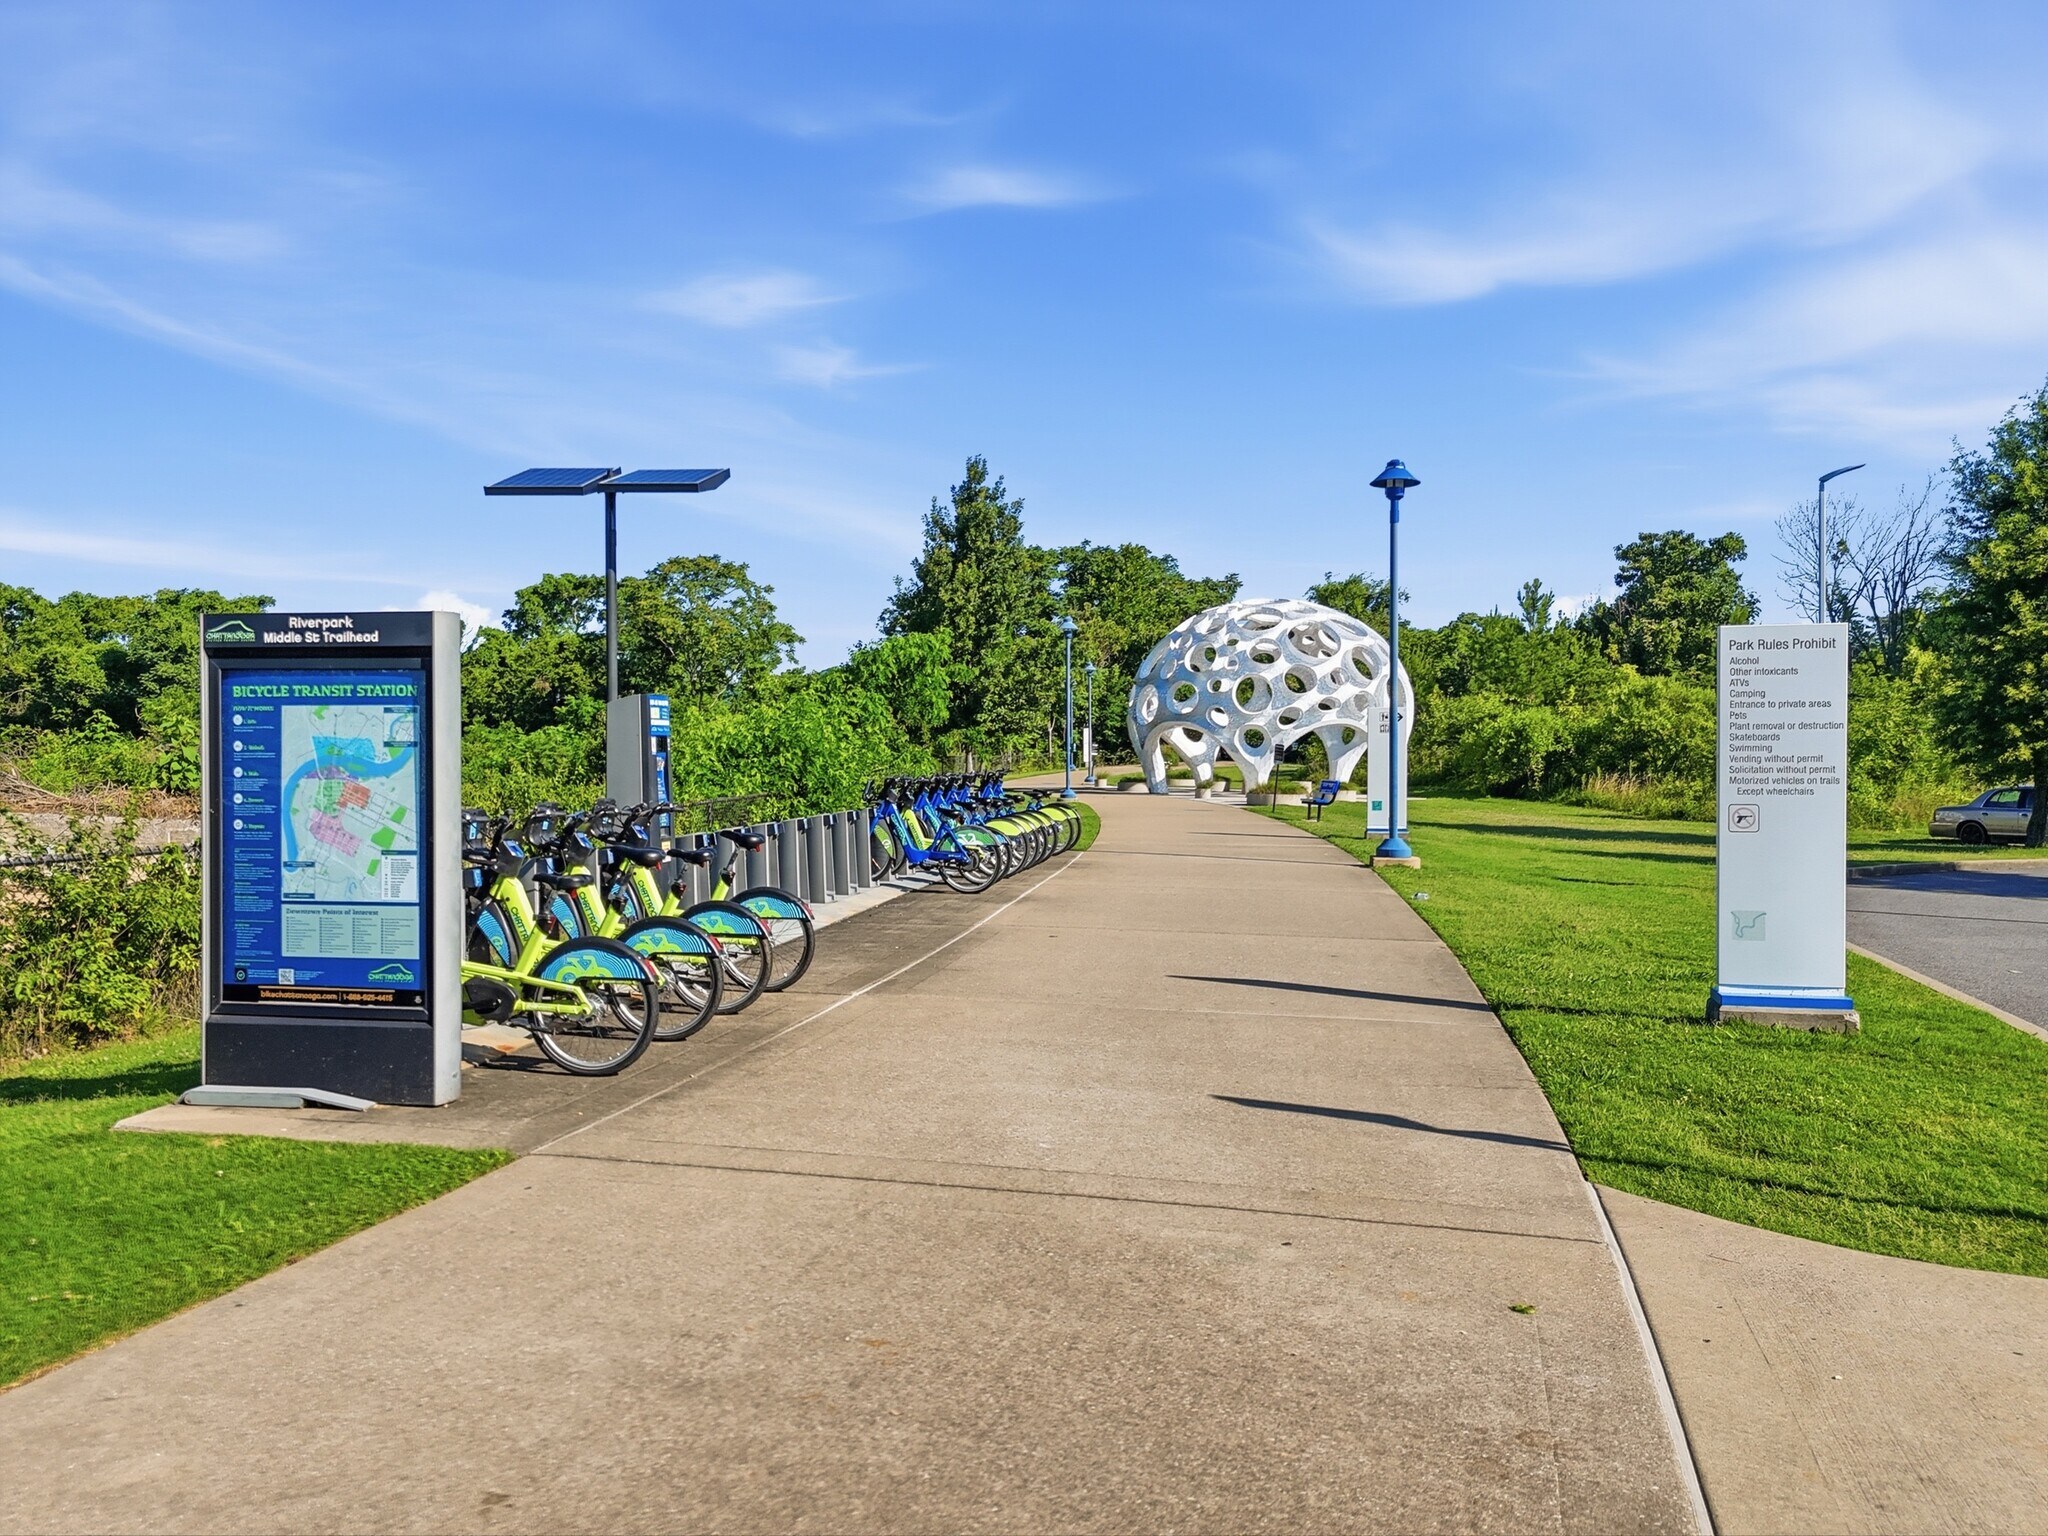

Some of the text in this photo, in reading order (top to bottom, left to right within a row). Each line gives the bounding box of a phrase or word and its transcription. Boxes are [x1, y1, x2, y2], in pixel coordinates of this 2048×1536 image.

[289, 616, 353, 630] Riverpark
[263, 631, 379, 644] Middle St Trailhead
[1729, 638, 1836, 651] Park Rules Prohibit
[1729, 657, 1759, 665] Alcohol
[1730, 667, 1799, 676] Other intoxicants
[1729, 679, 1749, 687] ATVs
[232, 684, 418, 697] BICYCLE TRANSIT STATION
[1730, 690, 1766, 699] Camping
[1730, 700, 1831, 709] Entrance to private areas
[1730, 711, 1747, 719] Pets
[1730, 722, 1750, 730] Plant
[1752, 722, 1785, 730] removal
[1798, 721, 1844, 730] destruction
[1729, 733, 1780, 741] Skateboards
[1729, 744, 1772, 753] Swimming
[1729, 755, 1824, 764] Vending without permit
[1729, 766, 1836, 775] Solicitation without permit
[1729, 777, 1769, 785] Motorized
[1772, 776, 1805, 784] vehicles
[1820, 776, 1840, 784] trails
[1737, 787, 1814, 797] Except wheelchairs
